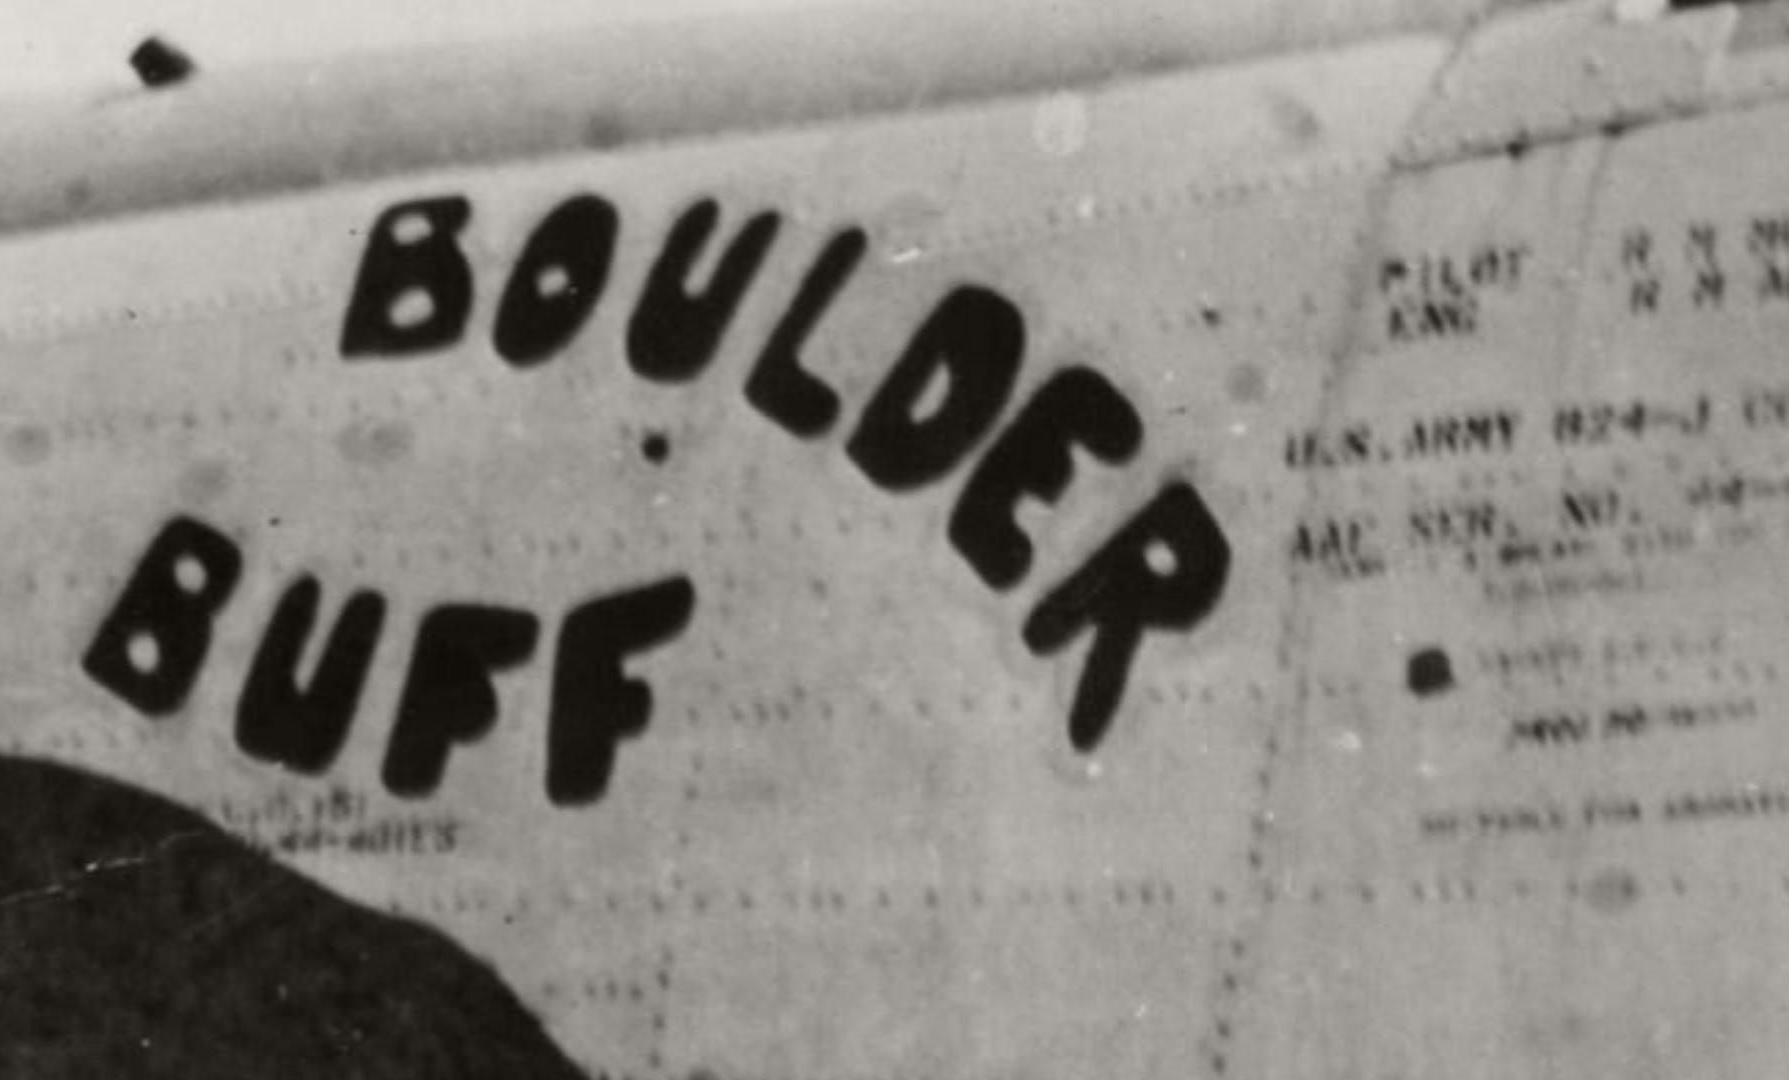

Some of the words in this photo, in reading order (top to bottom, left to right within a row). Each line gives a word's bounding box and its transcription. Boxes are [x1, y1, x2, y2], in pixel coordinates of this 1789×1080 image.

[1380, 244, 1529, 297] PILOT
[338, 193, 1231, 756] BOULDER
[81, 514, 696, 808] BUFF
